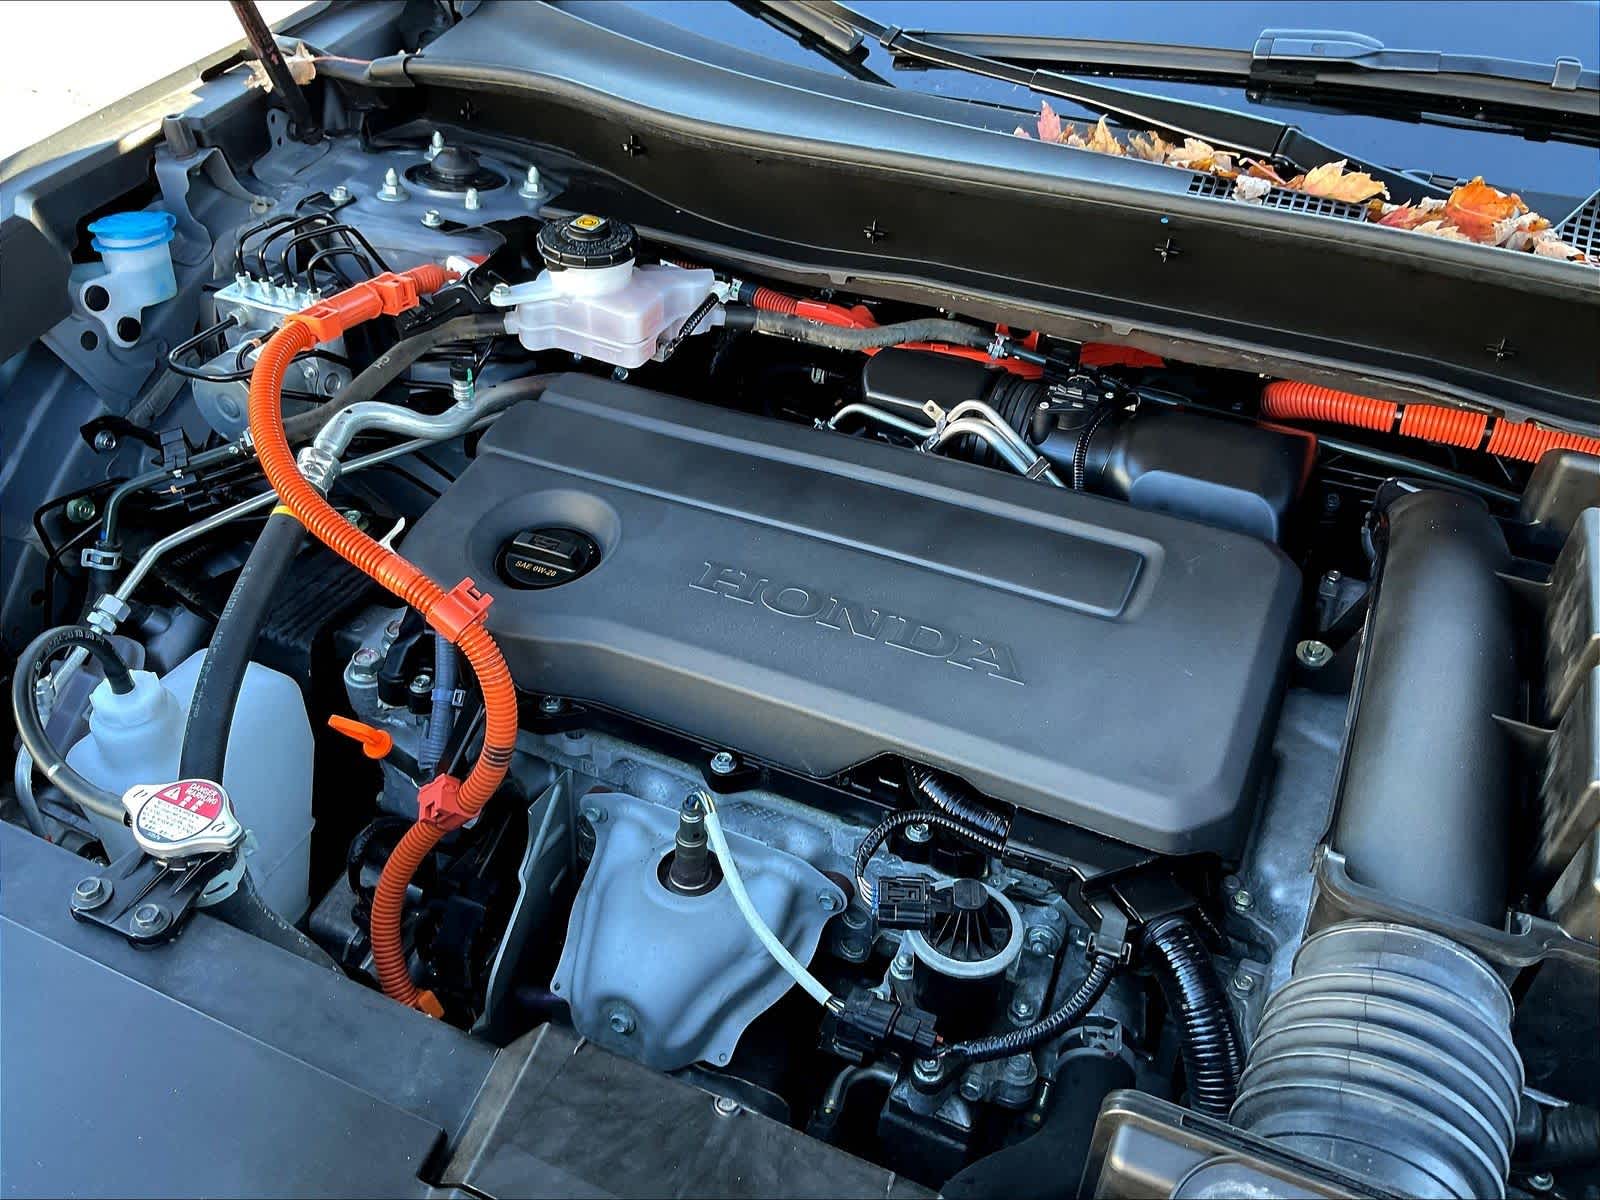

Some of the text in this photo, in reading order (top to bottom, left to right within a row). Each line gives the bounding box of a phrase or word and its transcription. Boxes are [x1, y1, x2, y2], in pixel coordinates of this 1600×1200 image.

[514, 560, 557, 577] SAE 0W-20
[688, 560, 1026, 686] HONDA
